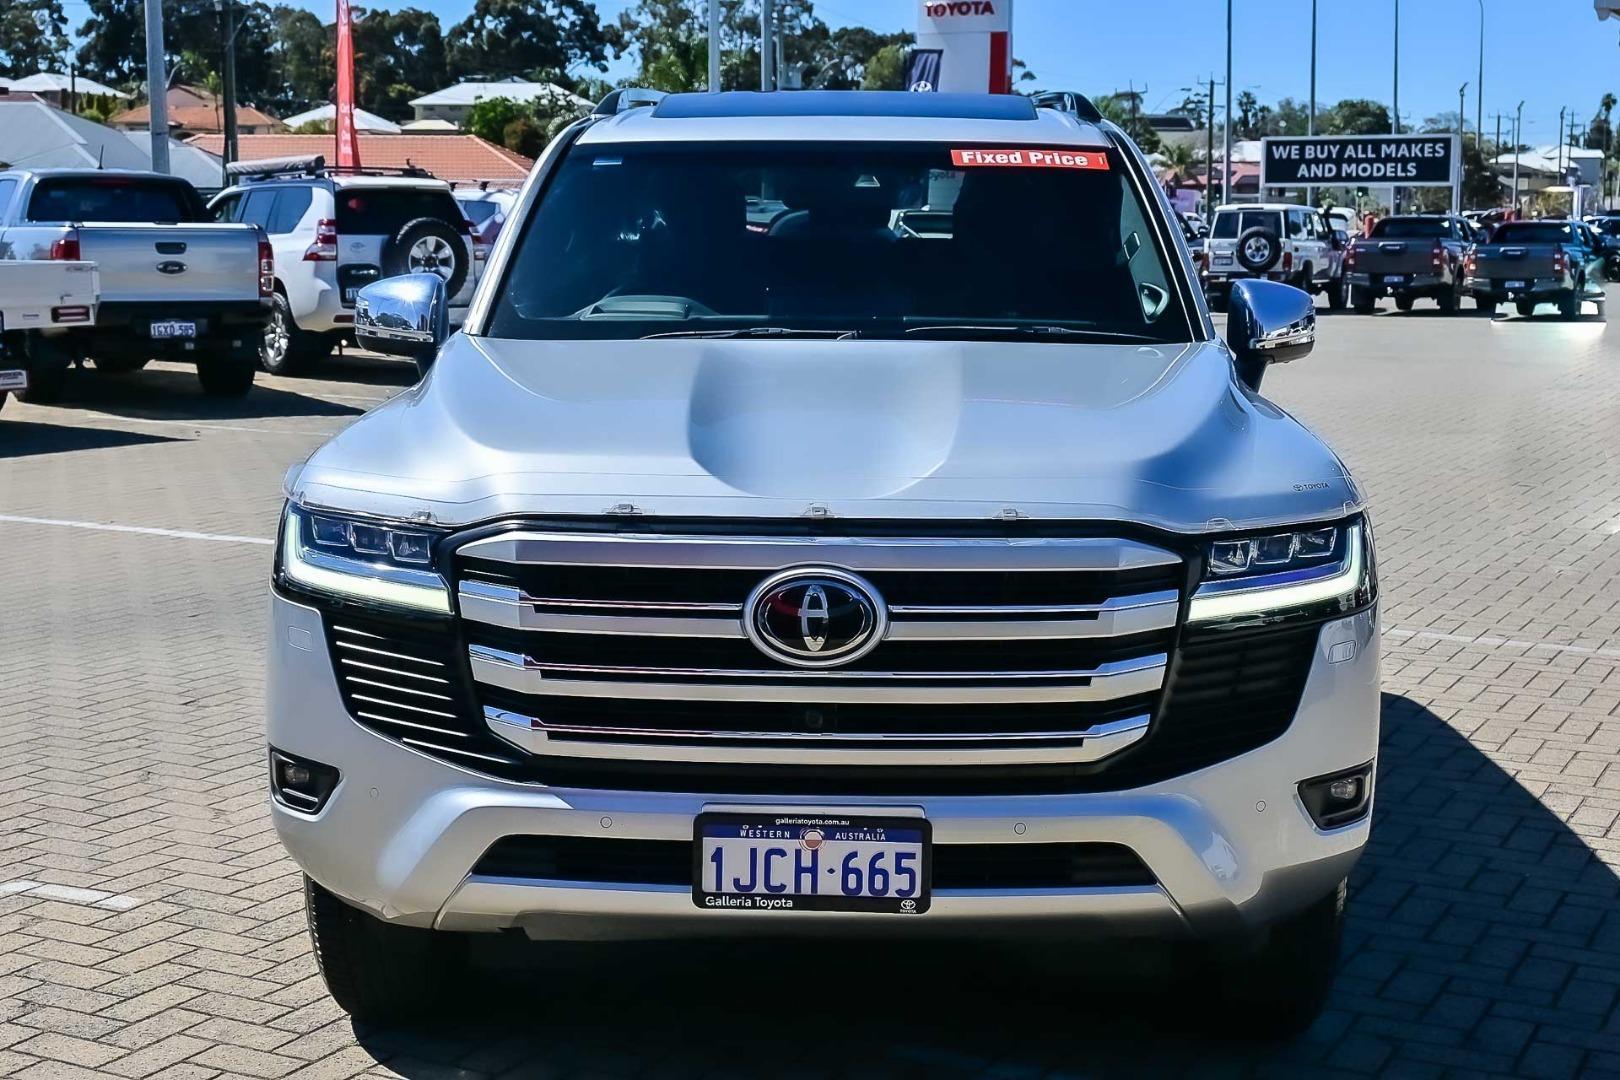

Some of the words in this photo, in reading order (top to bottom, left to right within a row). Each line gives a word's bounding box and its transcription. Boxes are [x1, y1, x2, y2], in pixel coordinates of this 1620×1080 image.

[925, 1, 995, 17] TOYOTA
[961, 151, 1023, 164] Fixed
[1029, 152, 1088, 166] Price
[1271, 145, 1300, 160] WE
[1304, 144, 1340, 159] BUY
[1343, 144, 1376, 159] ALL
[1381, 143, 1445, 158] MAKES
[1297, 163, 1336, 178] AND
[1342, 162, 1417, 177] MODELS
[1303, 482, 1330, 490] TOYOTA
[775, 817, 850, 826] galleriatoyota.com.au
[739, 829, 790, 839] WESTERN
[835, 831, 886, 841] AUSTRALIA
[705, 896, 752, 908] Galleria
[754, 897, 793, 910] Toyota
